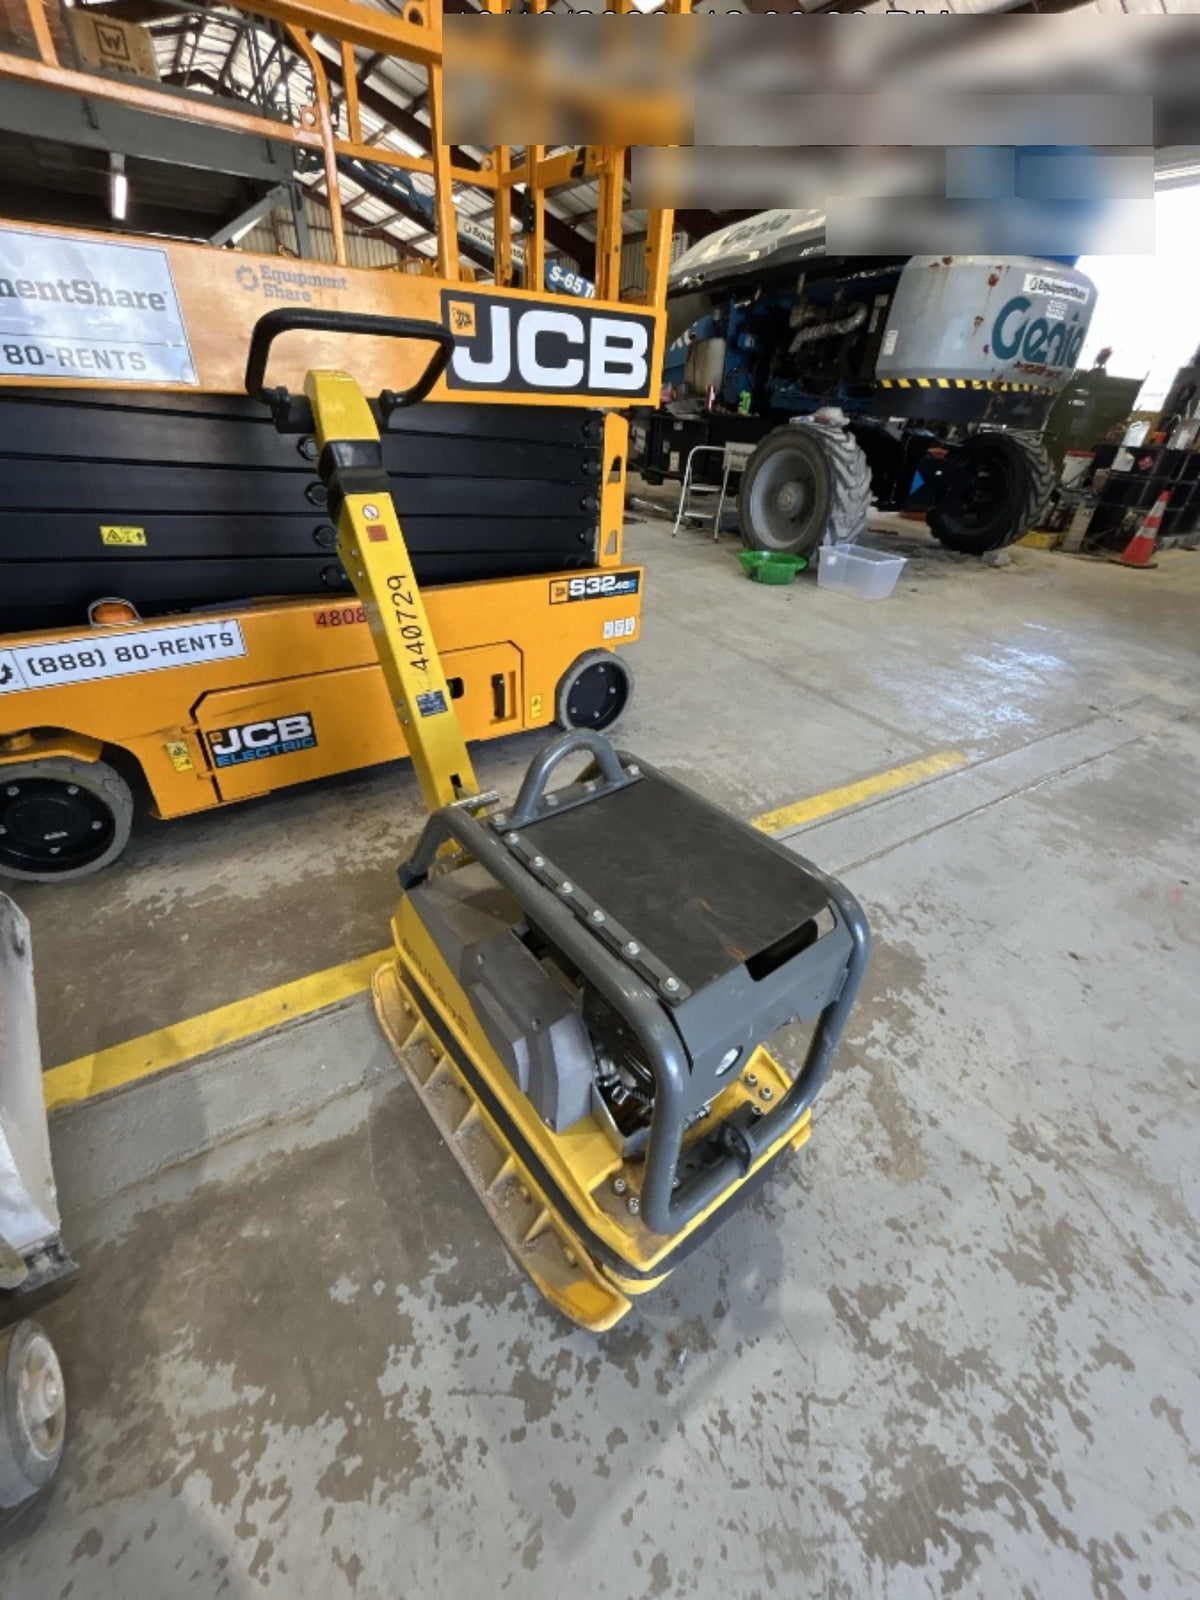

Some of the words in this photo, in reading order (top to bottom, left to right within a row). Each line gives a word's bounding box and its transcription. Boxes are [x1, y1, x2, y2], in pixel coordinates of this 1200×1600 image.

[259, 265, 349, 290] Equipment
[262, 282, 311, 302] Share
[549, 265, 584, 294] S-65
[2, 344, 147, 371] 80-RENTS
[451, 305, 648, 390] JCB
[386, 575, 430, 672] 440729
[26, 650, 107, 676] (888)
[114, 632, 234, 663] 80-RENTS
[213, 715, 312, 755] JCB
[216, 737, 315, 767] ELECTRIC
